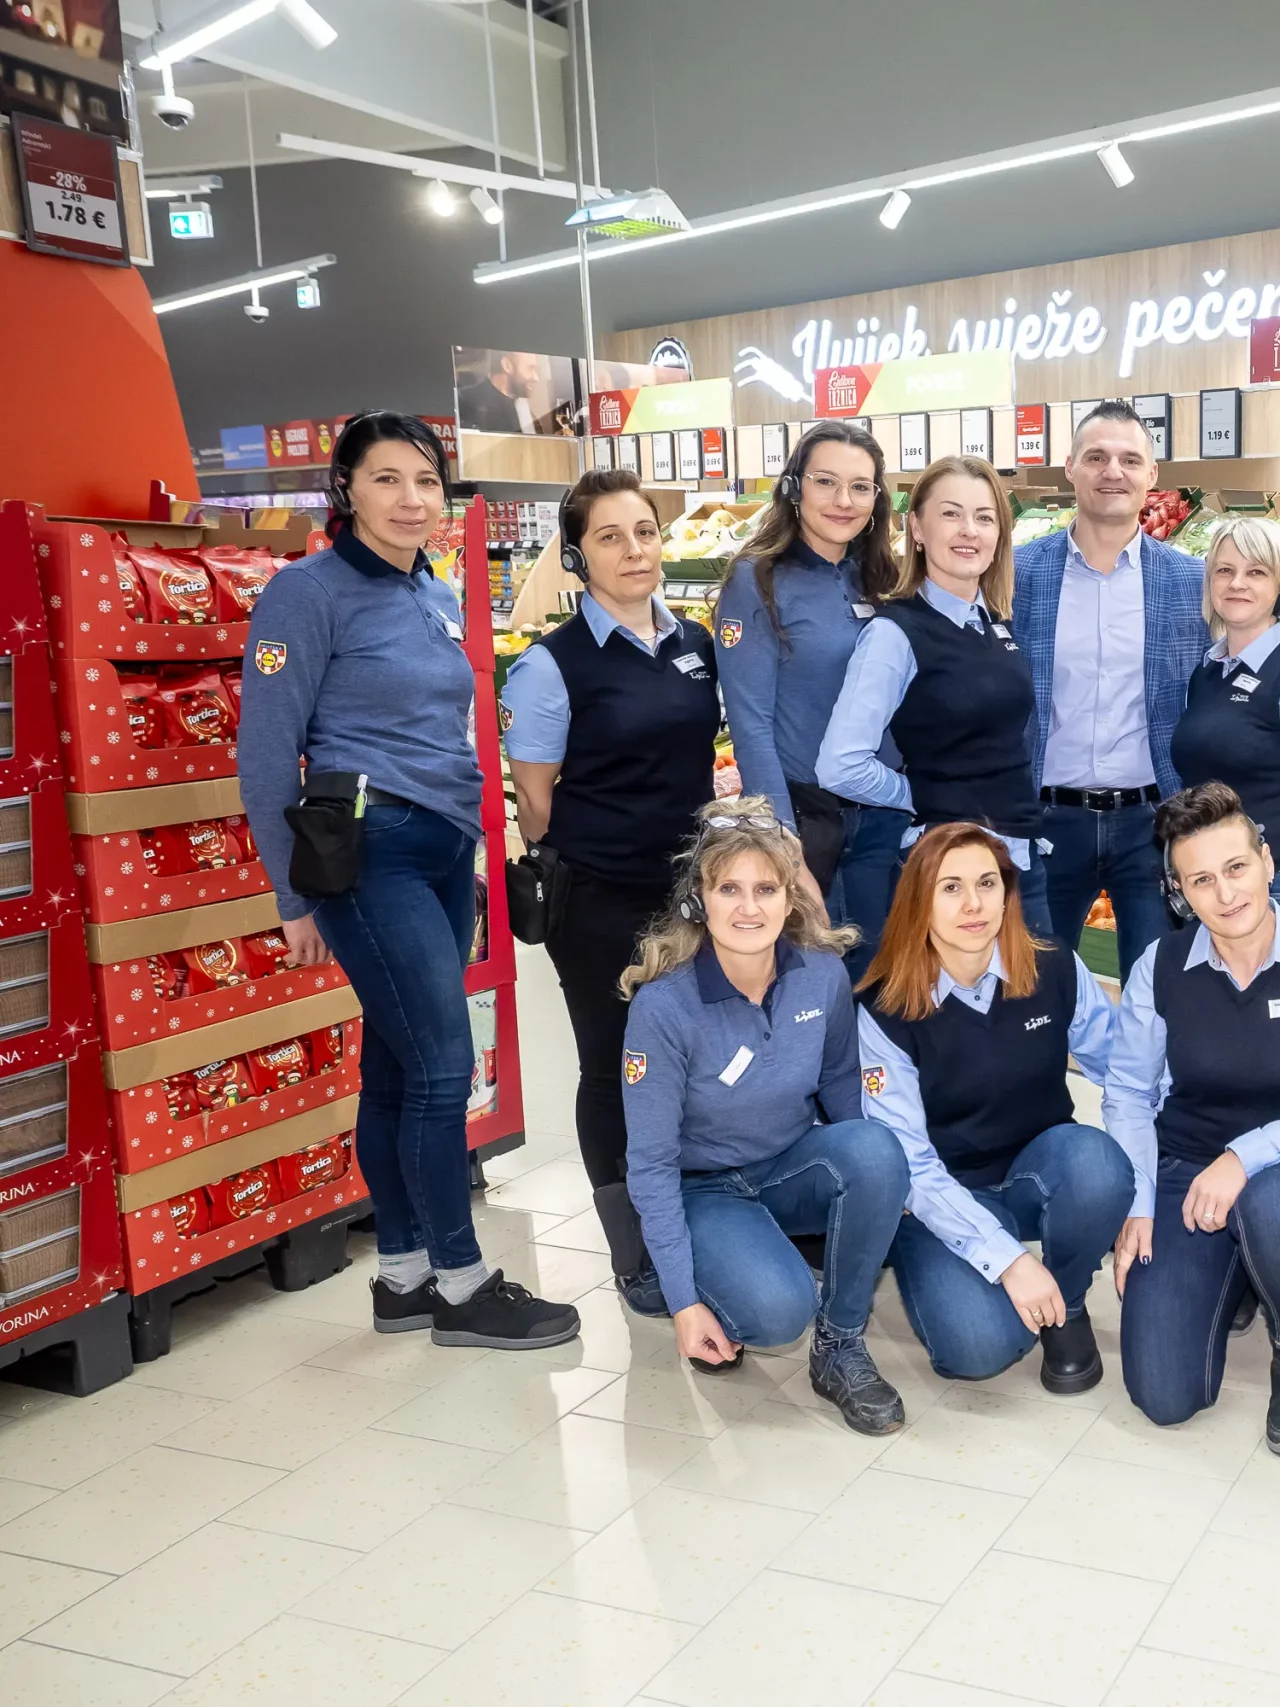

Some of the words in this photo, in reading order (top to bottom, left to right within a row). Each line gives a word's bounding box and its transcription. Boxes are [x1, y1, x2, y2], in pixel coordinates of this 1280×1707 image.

[50, 171, 87, 192] -28%
[45, 201, 87, 225] 1.78
[92, 211, 106, 229] €
[791, 304, 934, 384] Uvijek
[947, 289, 1109, 360] svježe
[1207, 430, 1222, 440] 1.19
[1224, 430, 1230, 440] €
[904, 447, 916, 456] 3.69
[917, 447, 922, 456] €
[966, 445, 978, 453] 1.99
[978, 444, 984, 452] €
[1021, 441, 1034, 450] 1.39
[1035, 441, 1040, 450] €
[168, 581, 206, 595] Tortica
[186, 708, 220, 725] Tortica
[189, 830, 217, 846] Tortica
[202, 948, 225, 967] Tortica
[794, 1008, 823, 1023] LIDL
[1024, 1015, 1051, 1030] LIDL
[266, 1044, 296, 1063] Tortica
[301, 1157, 332, 1176] Tortica
[233, 1181, 264, 1203] Tortica
